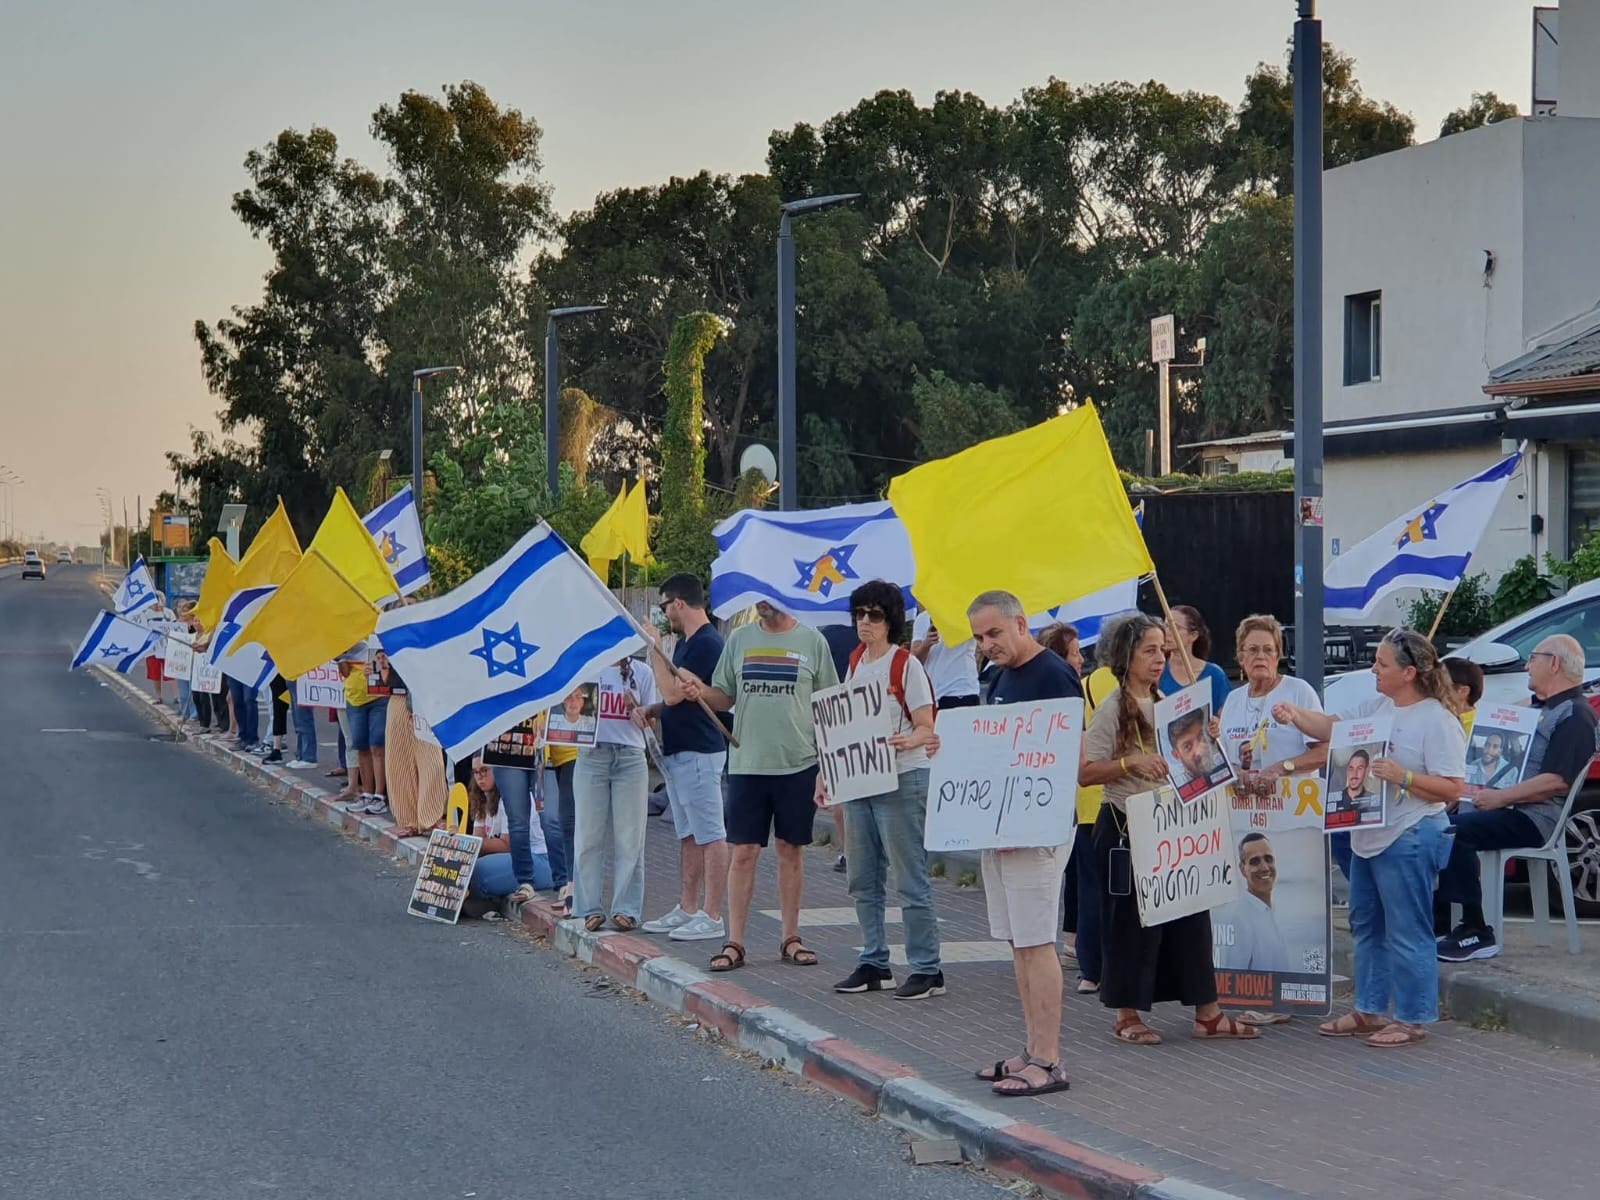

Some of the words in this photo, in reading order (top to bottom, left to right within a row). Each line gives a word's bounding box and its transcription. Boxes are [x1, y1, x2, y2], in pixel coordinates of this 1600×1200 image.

[743, 682, 795, 696] Carhartt
[853, 680, 882, 717] עד
[600, 691, 630, 716] OW
[811, 690, 852, 747] החטוף
[972, 716, 1008, 736] מצווה
[1012, 707, 1043, 751] לך
[1046, 712, 1071, 744] אין
[819, 736, 892, 797] האחרון!
[937, 779, 992, 813] שבויים
[995, 775, 1053, 835] פדיון
[1231, 796, 1254, 810] OMRI
[1255, 796, 1284, 811] MIRAN
[1249, 811, 1267, 828] (46)
[1152, 827, 1221, 873] מסכנת
[1206, 859, 1232, 886] את
[1213, 924, 1235, 946] ING
[1458, 936, 1479, 948] HOKA
[1215, 972, 1233, 995] ME
[1235, 973, 1273, 997] NOW!
